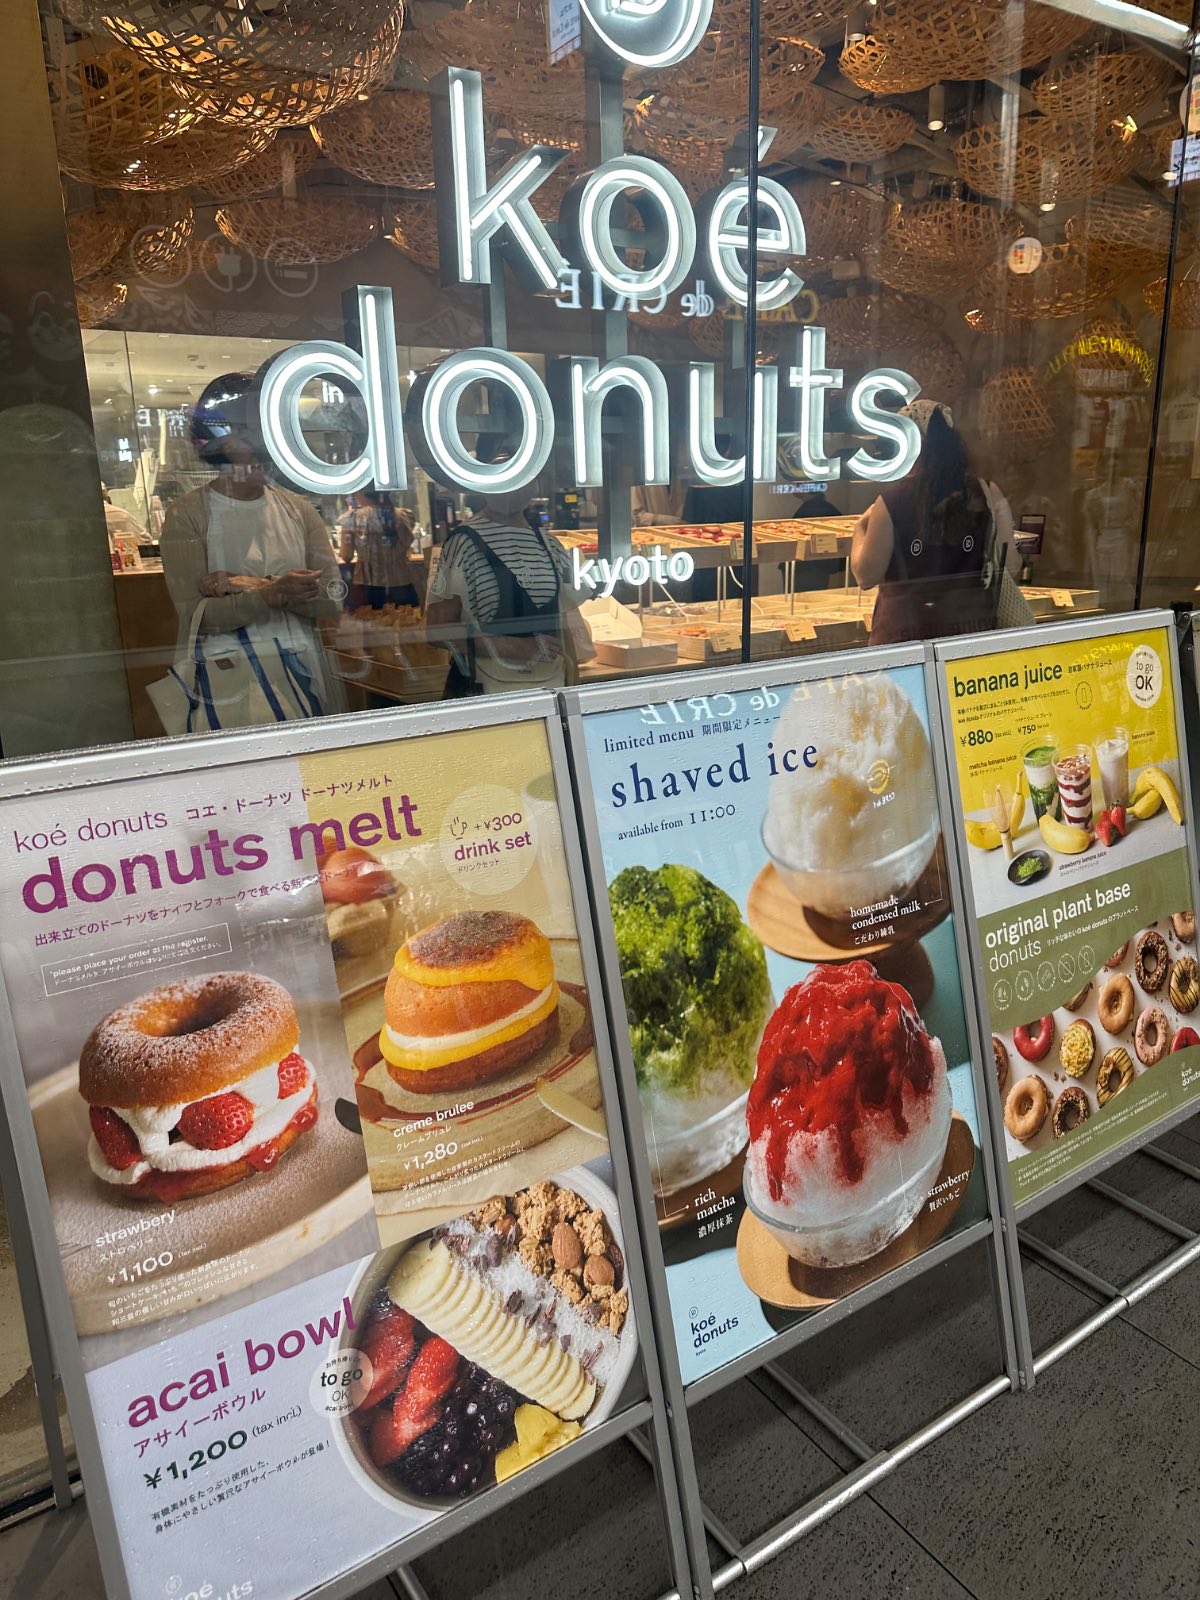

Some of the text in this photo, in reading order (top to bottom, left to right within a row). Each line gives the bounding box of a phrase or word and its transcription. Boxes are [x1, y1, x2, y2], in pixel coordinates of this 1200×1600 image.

[440, 66, 806, 311] koé
[258, 285, 920, 494] donuts
[572, 545, 695, 598] kyoto
[953, 671, 1019, 698] banana
[1024, 662, 1062, 689] juice
[1135, 674, 1153, 691] OK
[1136, 660, 1153, 674] to go
[604, 716, 781, 753] limited menu 期間限定メニュー
[960, 729, 993, 748] ¥880
[1018, 724, 1036, 735] ¥750
[611, 742, 818, 808] shaved ice
[969, 755, 1017, 770] matcha banana juice
[186, 774, 393, 820] コエ・ドーナツ ドーナツメルト
[13, 810, 168, 852] koé donuts
[618, 804, 736, 841] available from 11:00
[22, 794, 423, 914] donuts melt
[454, 831, 532, 862] drink set
[457, 857, 500, 873] ドリンクセット
[1059, 860, 1081, 871] strawberry
[1082, 855, 1097, 864] banana
[850, 895, 899, 918] homemade
[852, 900, 921, 930] condensed milk
[985, 883, 1131, 949] original plant base
[854, 925, 895, 945] こだわり練乳
[83, 957, 108, 972] place
[109, 954, 127, 967] your
[129, 948, 151, 961] order
[162, 941, 177, 953] the
[989, 940, 1041, 973] donuts
[393, 1100, 475, 1138] creme brulee
[396, 1125, 452, 1152] クレームブリュレ
[403, 1141, 458, 1171] ¥1,280
[694, 1187, 717, 1207] rich
[927, 1170, 970, 1198] strawberry
[696, 1194, 736, 1220] matcha
[95, 1209, 176, 1248] strawbery
[698, 1213, 733, 1239] 濃厚抹茶
[99, 1238, 154, 1263] ストロベリー
[107, 1251, 174, 1284] ¥1,100
[691, 1312, 716, 1335] koé
[693, 1315, 739, 1348] donuts
[127, 1296, 359, 1428] acai bowl
[321, 1368, 363, 1387] to go
[332, 1390, 350, 1402] OK
[134, 1387, 266, 1458] アサイーボウル
[144, 1429, 248, 1489] ¥1,200
[252, 1421, 274, 1438] (tax
